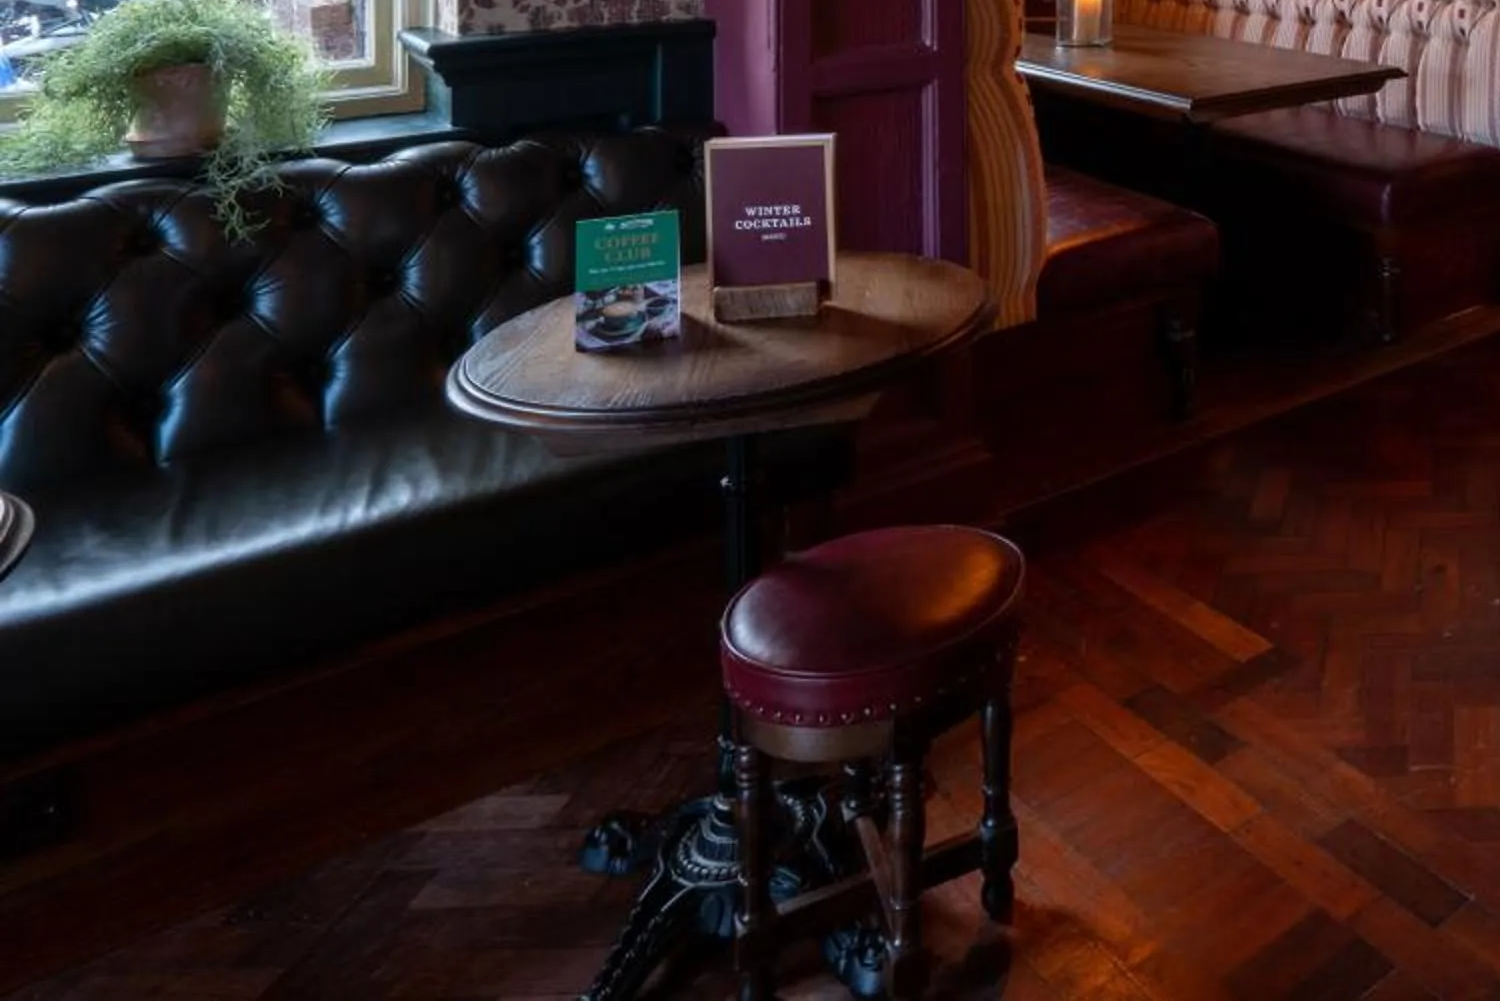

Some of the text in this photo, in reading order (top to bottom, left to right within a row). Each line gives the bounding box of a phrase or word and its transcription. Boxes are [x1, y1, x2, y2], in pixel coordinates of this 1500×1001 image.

[745, 205, 801, 216] WINTER
[735, 216, 812, 230] COCKTAILS
[594, 232, 658, 250] COFFEE
[604, 247, 651, 263] CLUB
